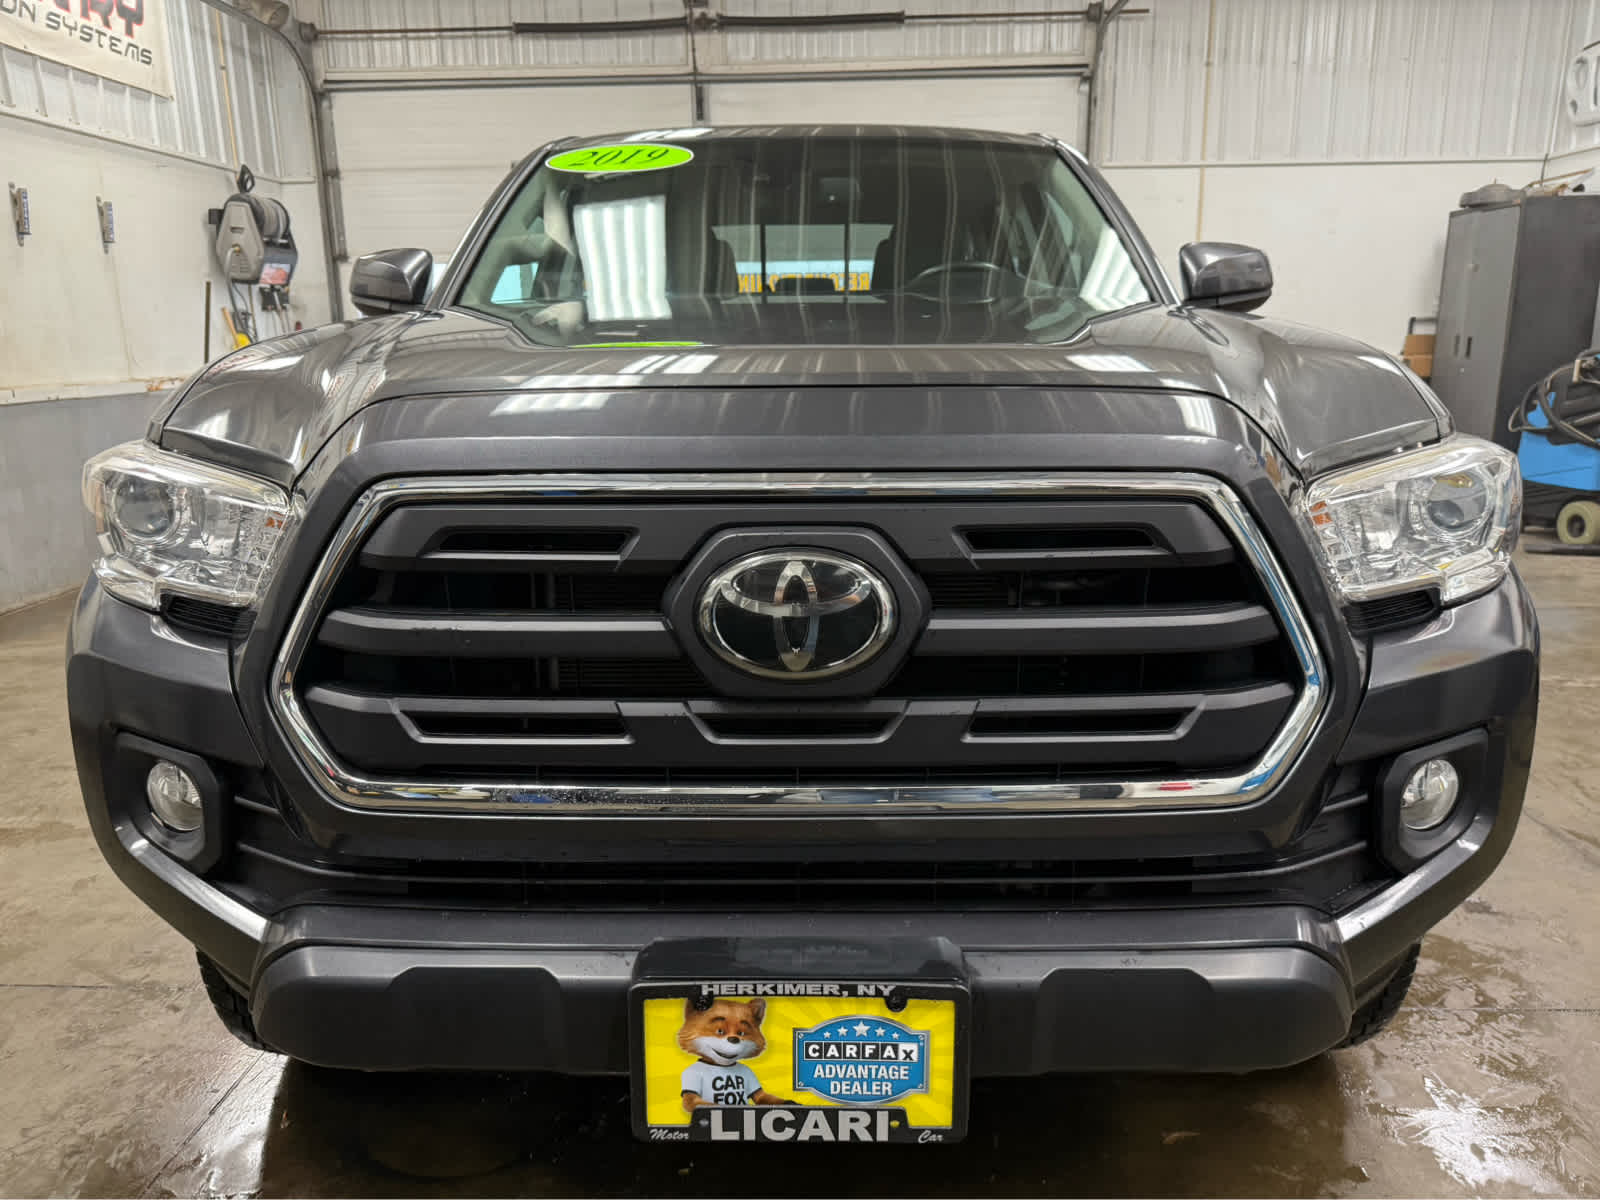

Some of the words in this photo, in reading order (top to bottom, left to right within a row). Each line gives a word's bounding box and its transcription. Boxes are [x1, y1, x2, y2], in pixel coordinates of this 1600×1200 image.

[45, 11, 153, 66] SYSTEMS
[567, 148, 670, 166] 2019
[701, 983, 849, 998] HERKIMER,
[857, 984, 897, 996] NY
[806, 1042, 917, 1062] CARFAX
[813, 1064, 911, 1080] ADVANTAGE
[711, 1075, 745, 1092] CAR
[829, 1080, 893, 1096] DEALER
[713, 1091, 747, 1106] FOX
[649, 1127, 689, 1141] Motor
[710, 1109, 890, 1142] LICARI
[917, 1129, 944, 1144] Car
